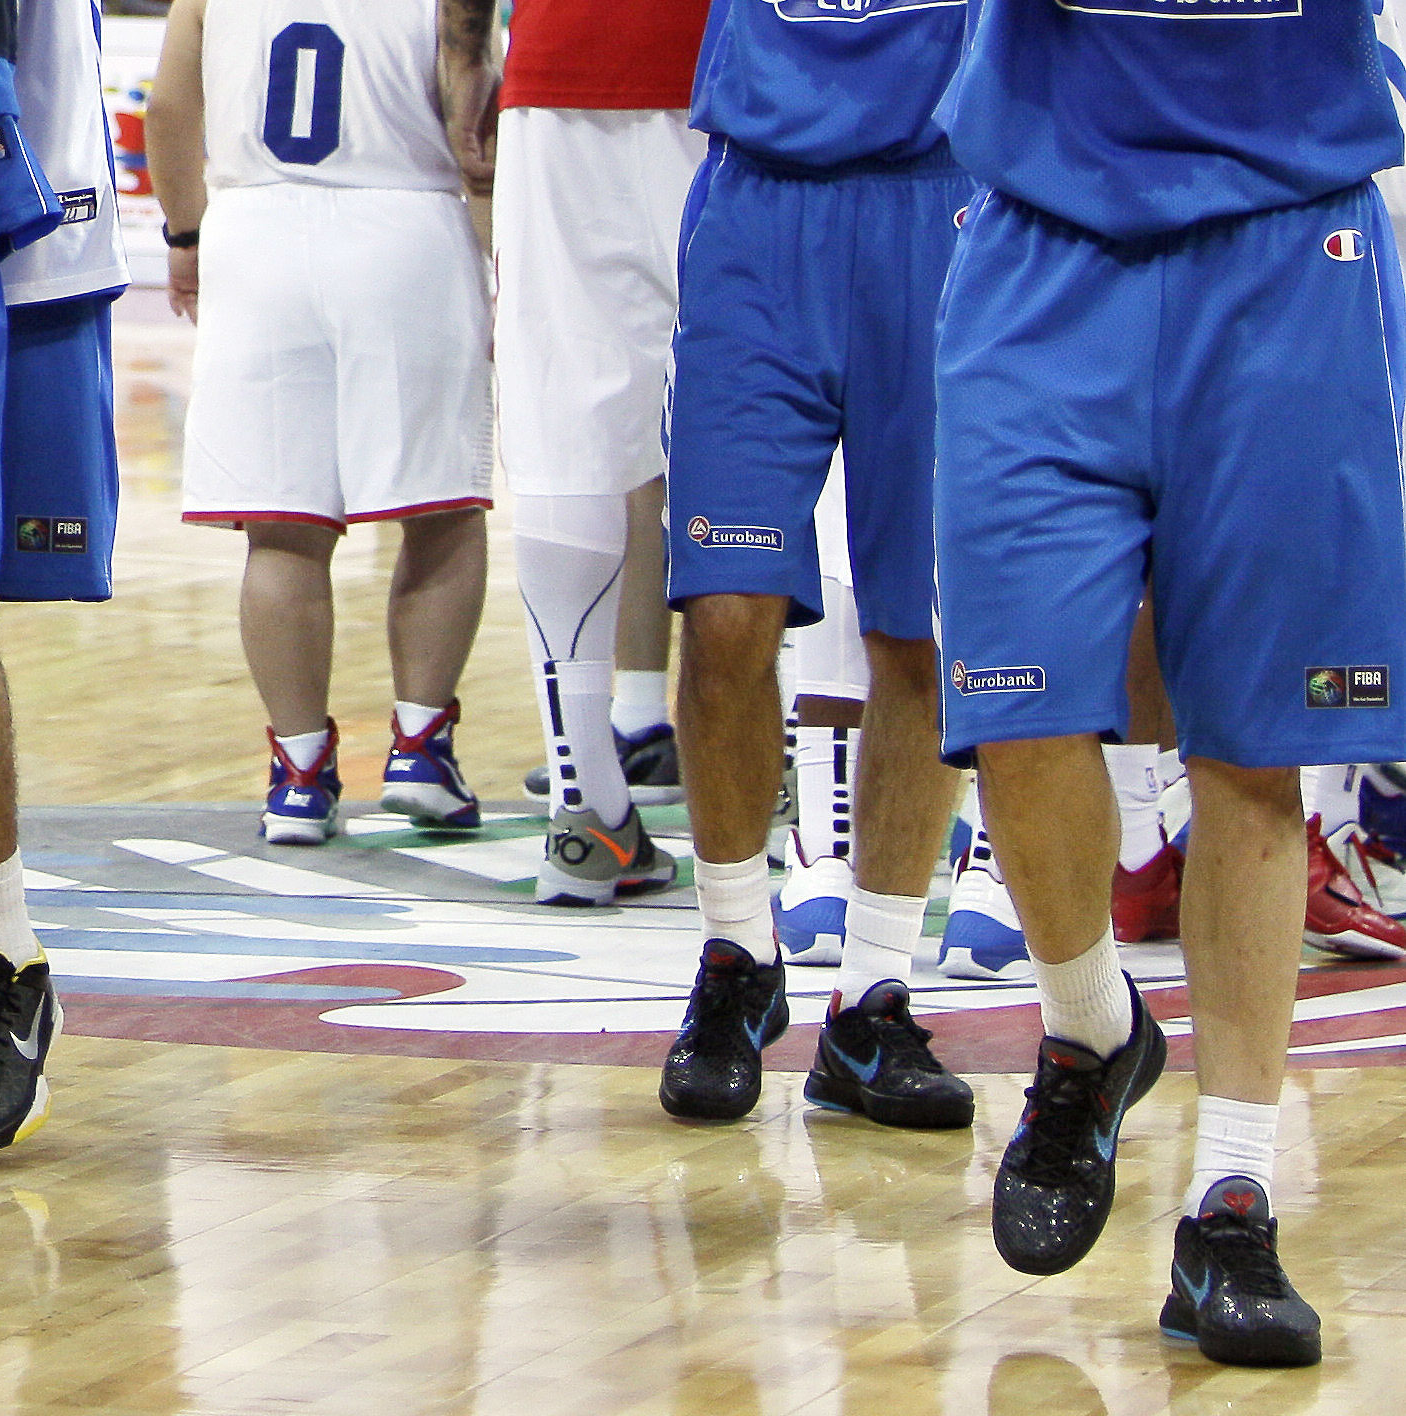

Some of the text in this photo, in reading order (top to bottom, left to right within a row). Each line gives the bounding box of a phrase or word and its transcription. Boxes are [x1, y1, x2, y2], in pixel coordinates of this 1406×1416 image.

[263, 21, 346, 166] 0
[57, 522, 82, 535] FIBA
[711, 530, 778, 546] Eurobank
[968, 671, 1036, 691] Eurobank
[1353, 671, 1382, 686] FIBA
